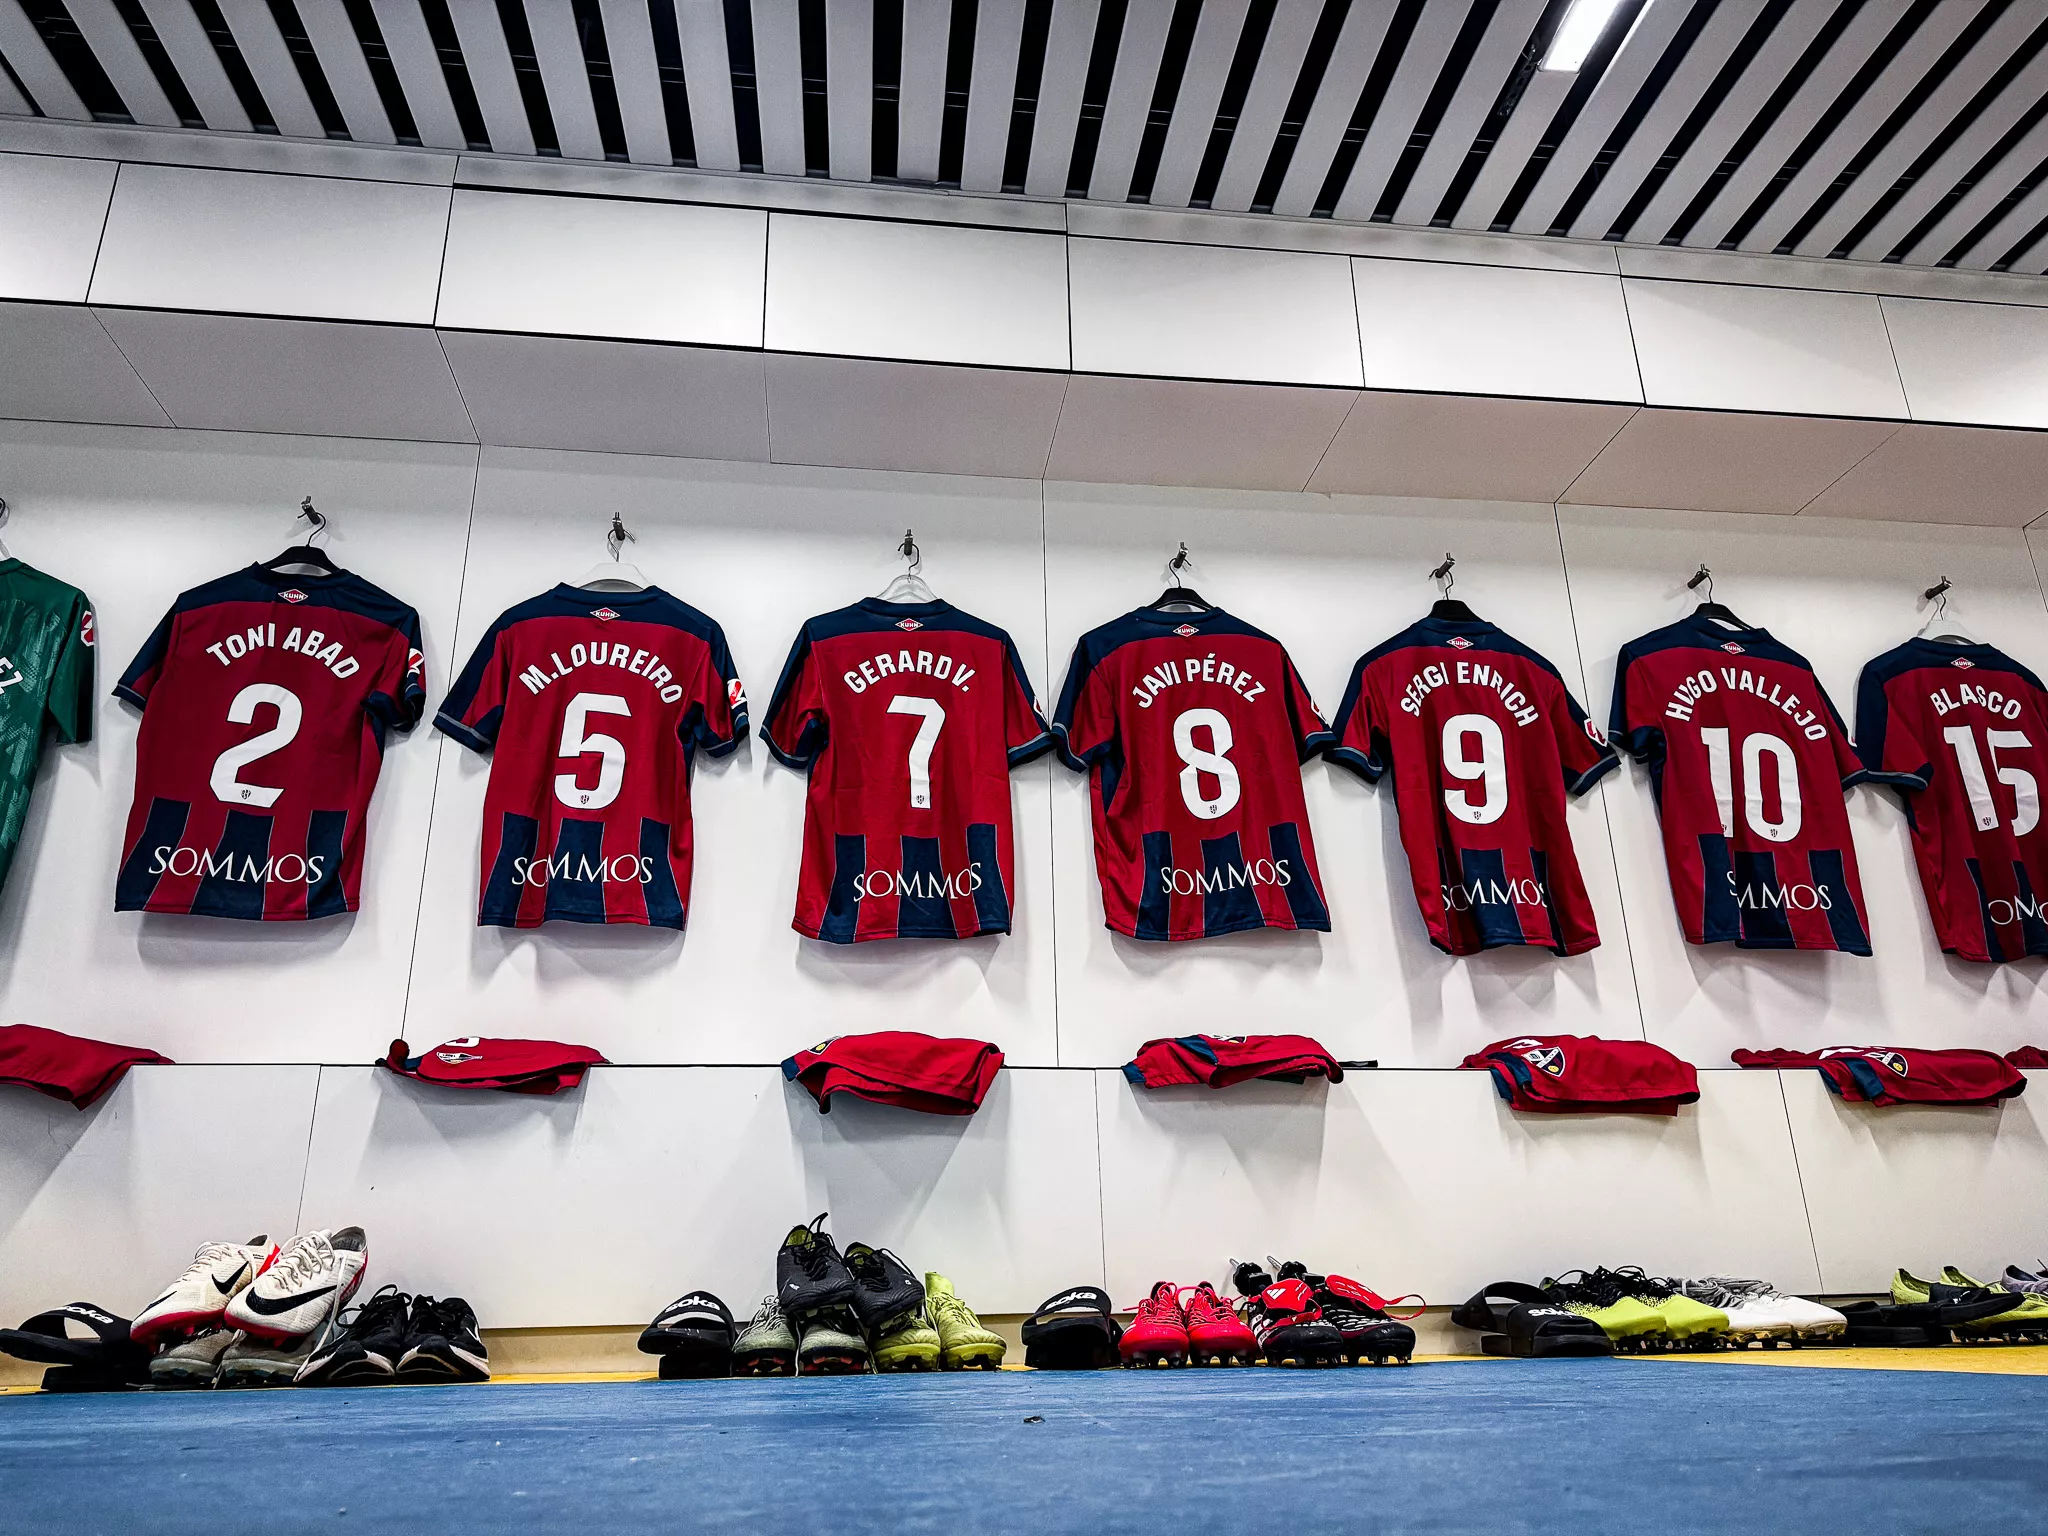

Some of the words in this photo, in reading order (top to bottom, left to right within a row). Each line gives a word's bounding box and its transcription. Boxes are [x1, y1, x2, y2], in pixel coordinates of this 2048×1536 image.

[283, 591, 304, 600] KUHN
[206, 623, 276, 667] TONI
[283, 628, 360, 679] ABAD
[518, 641, 683, 704] M.LOUREIRO
[843, 649, 953, 694] GERARD
[951, 663, 976, 692] V.
[1132, 661, 1182, 708] JAVI
[1186, 653, 1266, 703] PÉREZ
[1400, 661, 1450, 717] SERGI
[1456, 661, 1539, 727] ENRICH
[1665, 670, 1718, 722] HUGO
[1720, 667, 1828, 741] VALLEJO
[1929, 683, 2022, 720] BLASCO
[209, 683, 303, 808] 2
[554, 692, 632, 810] 5
[886, 695, 946, 810] 7
[1172, 708, 1241, 820] 8
[1442, 713, 1508, 825] 9
[1700, 726, 1802, 843] 10
[1943, 725, 2040, 837] 15
[148, 845, 325, 884] SOMMOS
[511, 851, 654, 888] SOMMOS
[853, 862, 982, 903] SOMMOS
[1160, 858, 1291, 896] SOMMOS
[1726, 870, 1832, 910] SMMOS
[664, 1295, 721, 1313] soka
[1044, 1291, 1098, 1311] soka
